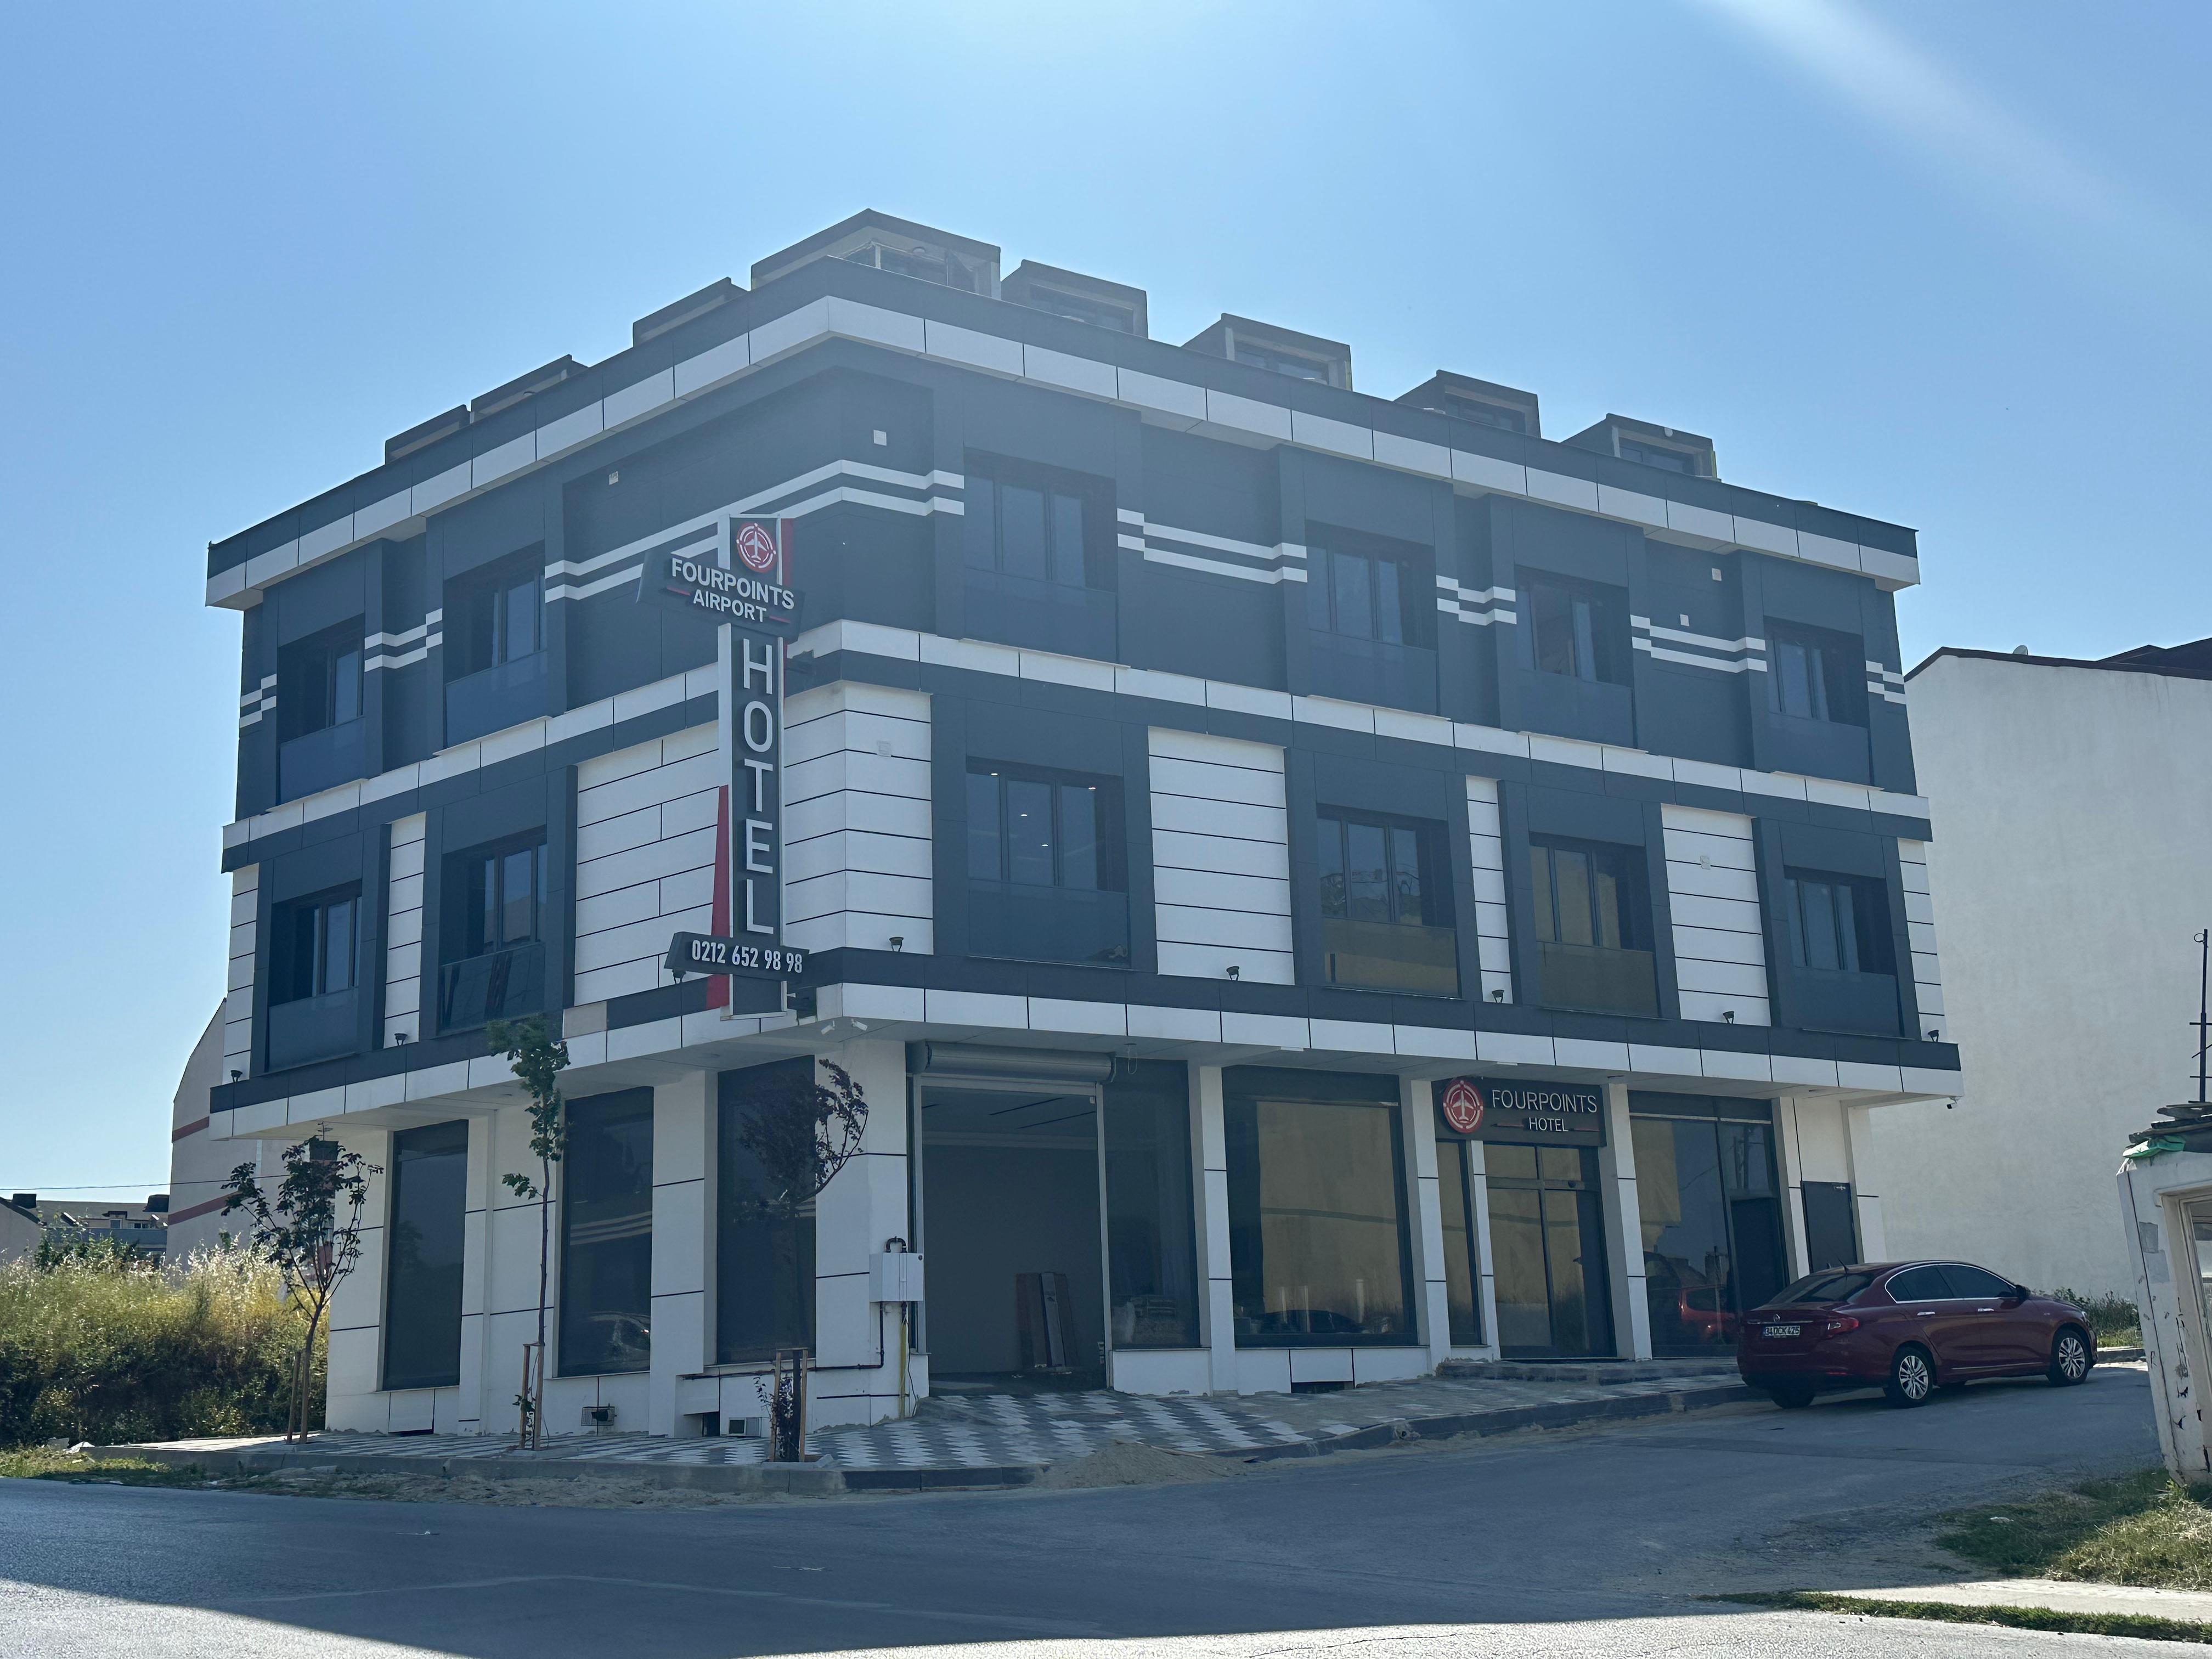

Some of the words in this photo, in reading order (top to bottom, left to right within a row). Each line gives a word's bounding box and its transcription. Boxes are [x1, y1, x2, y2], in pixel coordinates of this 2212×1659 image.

[672, 557, 794, 610] FOURPOINTS
[693, 589, 767, 623] AIRPORT
[743, 638, 774, 935] HOTEL
[692, 940, 726, 964] 0212
[732, 945, 758, 968] 652
[764, 950, 781, 970] 98
[786, 952, 803, 973] 98
[1492, 1090, 1598, 1113] FOURPOINTS
[1528, 1116, 1568, 1132] HOTEL
